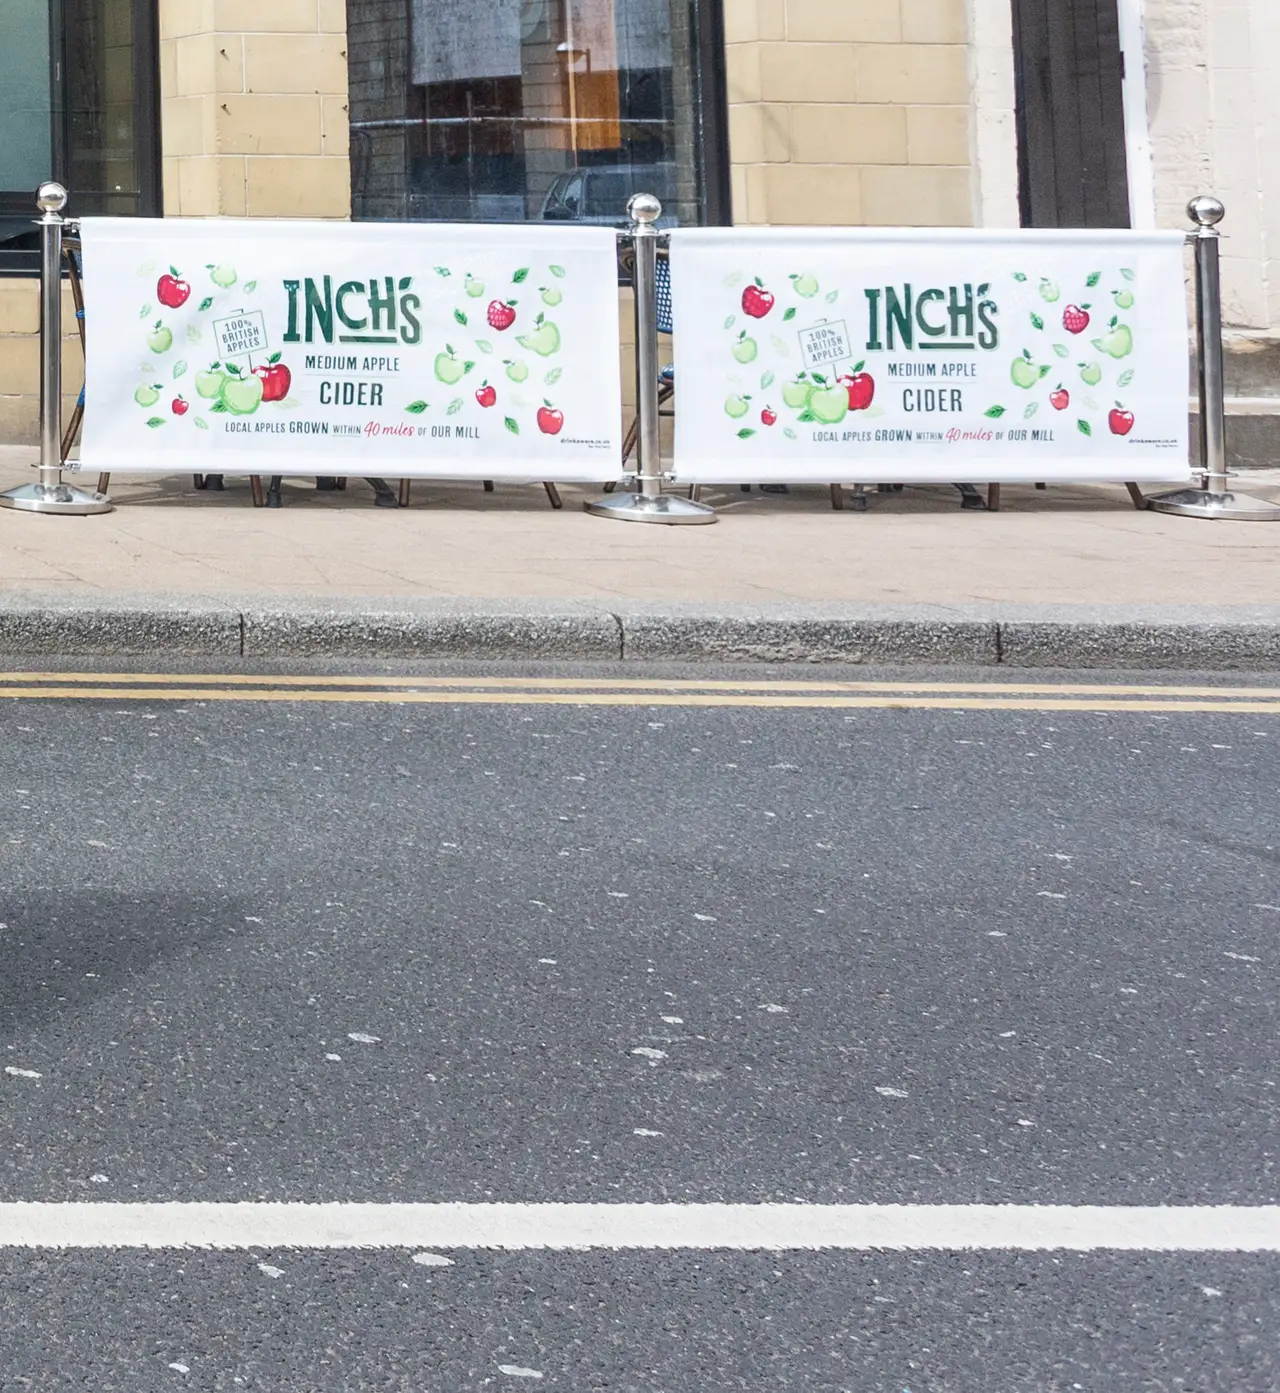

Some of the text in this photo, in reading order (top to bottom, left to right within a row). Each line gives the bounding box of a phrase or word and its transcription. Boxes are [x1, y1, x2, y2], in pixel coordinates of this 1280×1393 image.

[224, 319, 252, 332] 100%
[222, 327, 259, 344] BRITISH
[809, 329, 835, 343] 100%
[227, 336, 260, 353] APPLES
[807, 336, 843, 353] BRITISH
[305, 355, 400, 371] MEDIUM APPLE
[812, 347, 844, 363] APPLES
[887, 363, 977, 377] MEDIUM APPLE
[320, 381, 383, 406] CIDER
[903, 389, 963, 412] CIDER
[225, 421, 480, 439] LOCAL APPLES GROWN WITHIN 40 miles OF OUR MILL
[812, 427, 1055, 443] LOCAL APPLES GROWN WITHIN 40 miles OF OUR MILL
